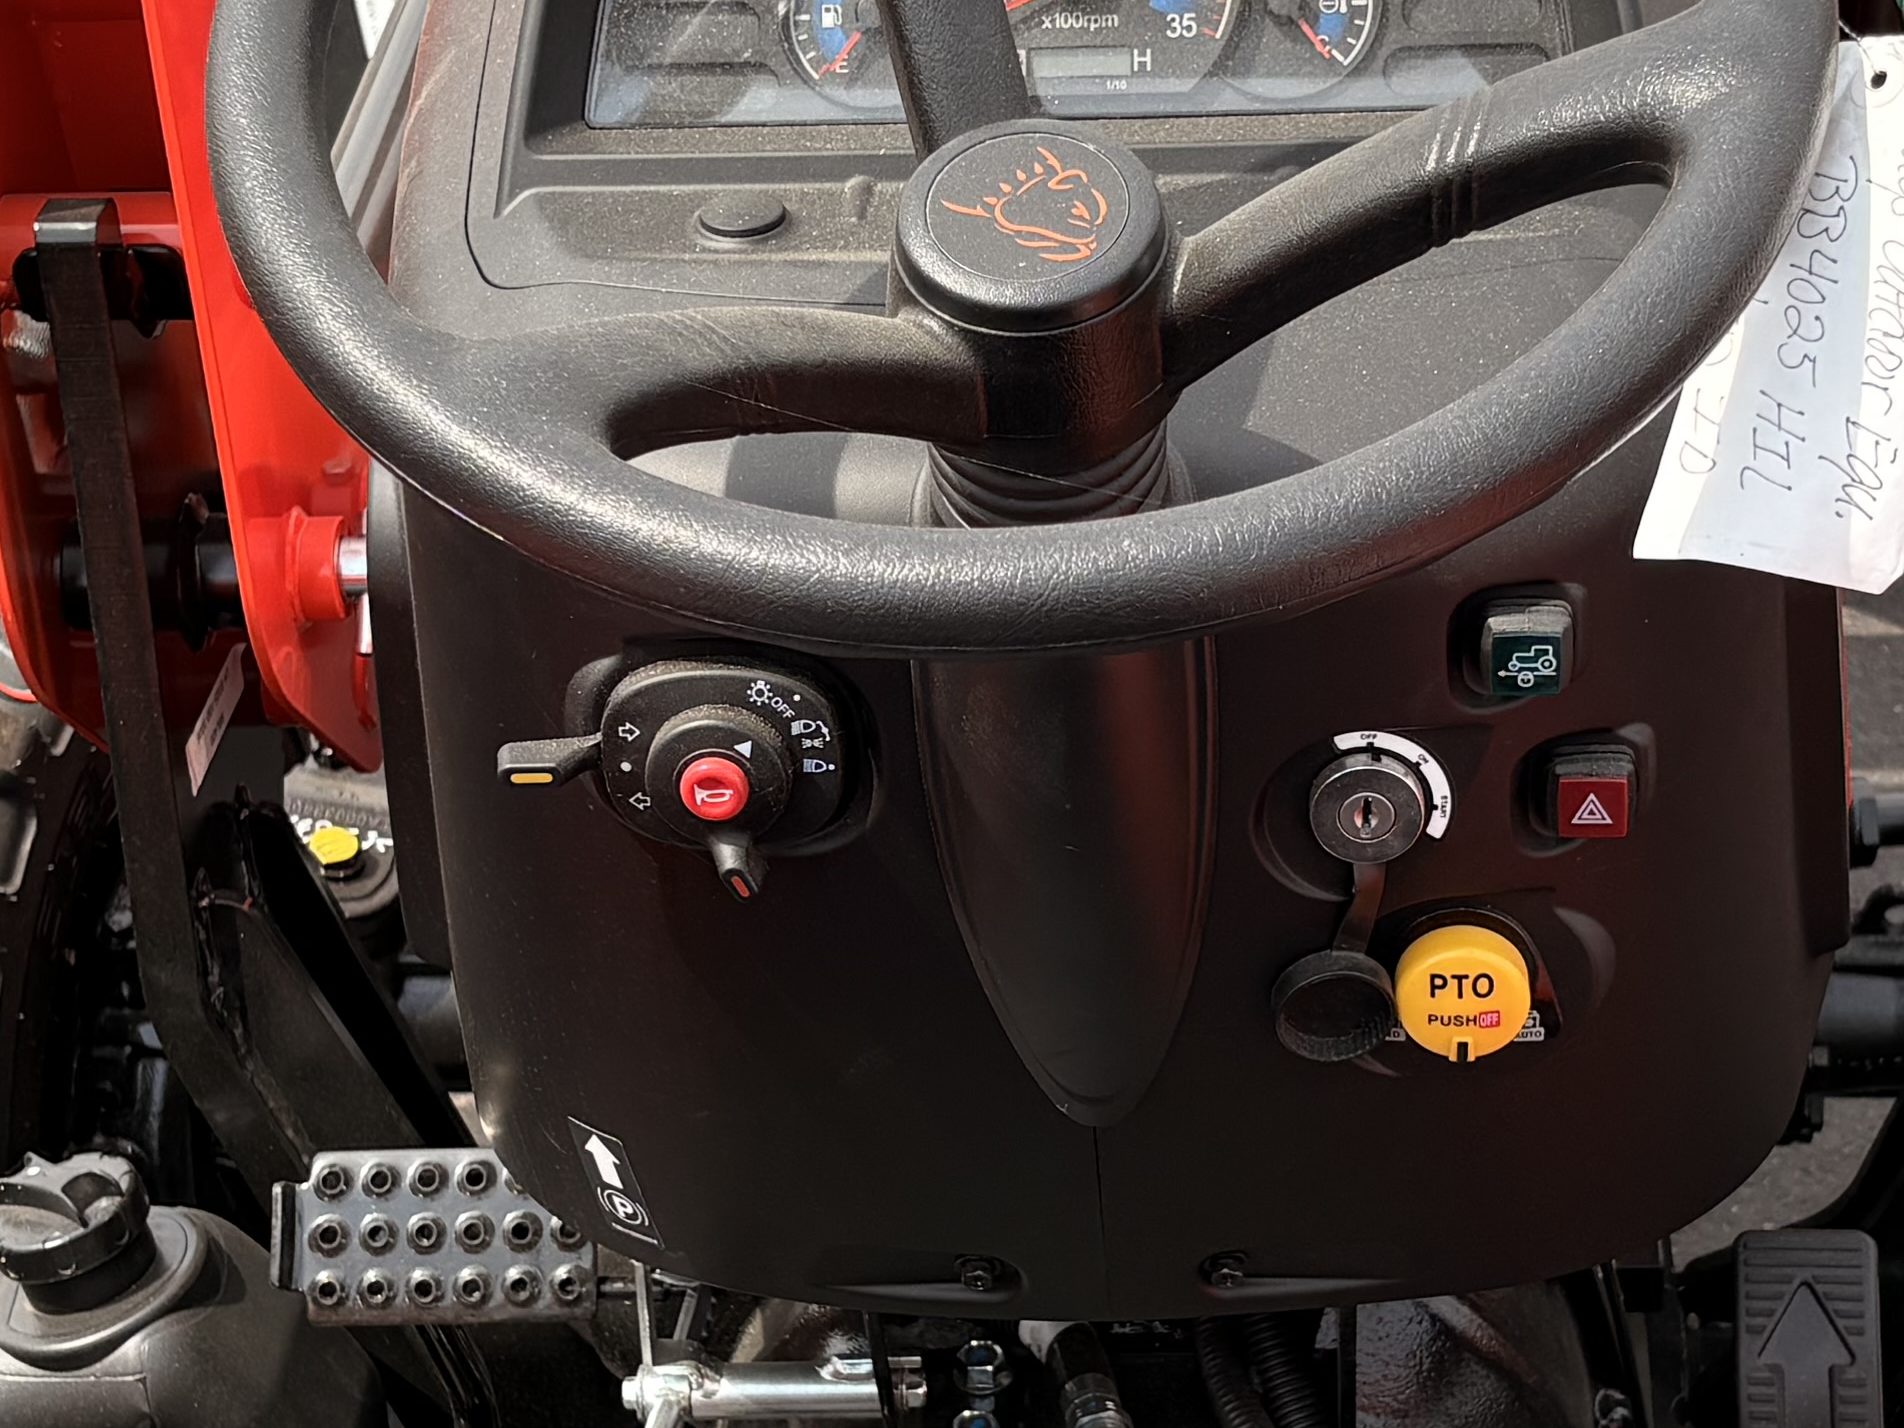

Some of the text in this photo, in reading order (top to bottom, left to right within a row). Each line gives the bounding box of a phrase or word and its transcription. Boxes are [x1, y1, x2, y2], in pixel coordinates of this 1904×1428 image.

[1041, 12, 1119, 33] x100rpm
[1165, 15, 1197, 39] 35
[1133, 49, 1152, 72] H
[1105, 80, 1127, 90] 1/10
[771, 697, 796, 719] OFF
[1360, 733, 1378, 741] OFF
[1429, 973, 1495, 999] PTO
[1428, 1012, 1499, 1027] PUSH OFF
